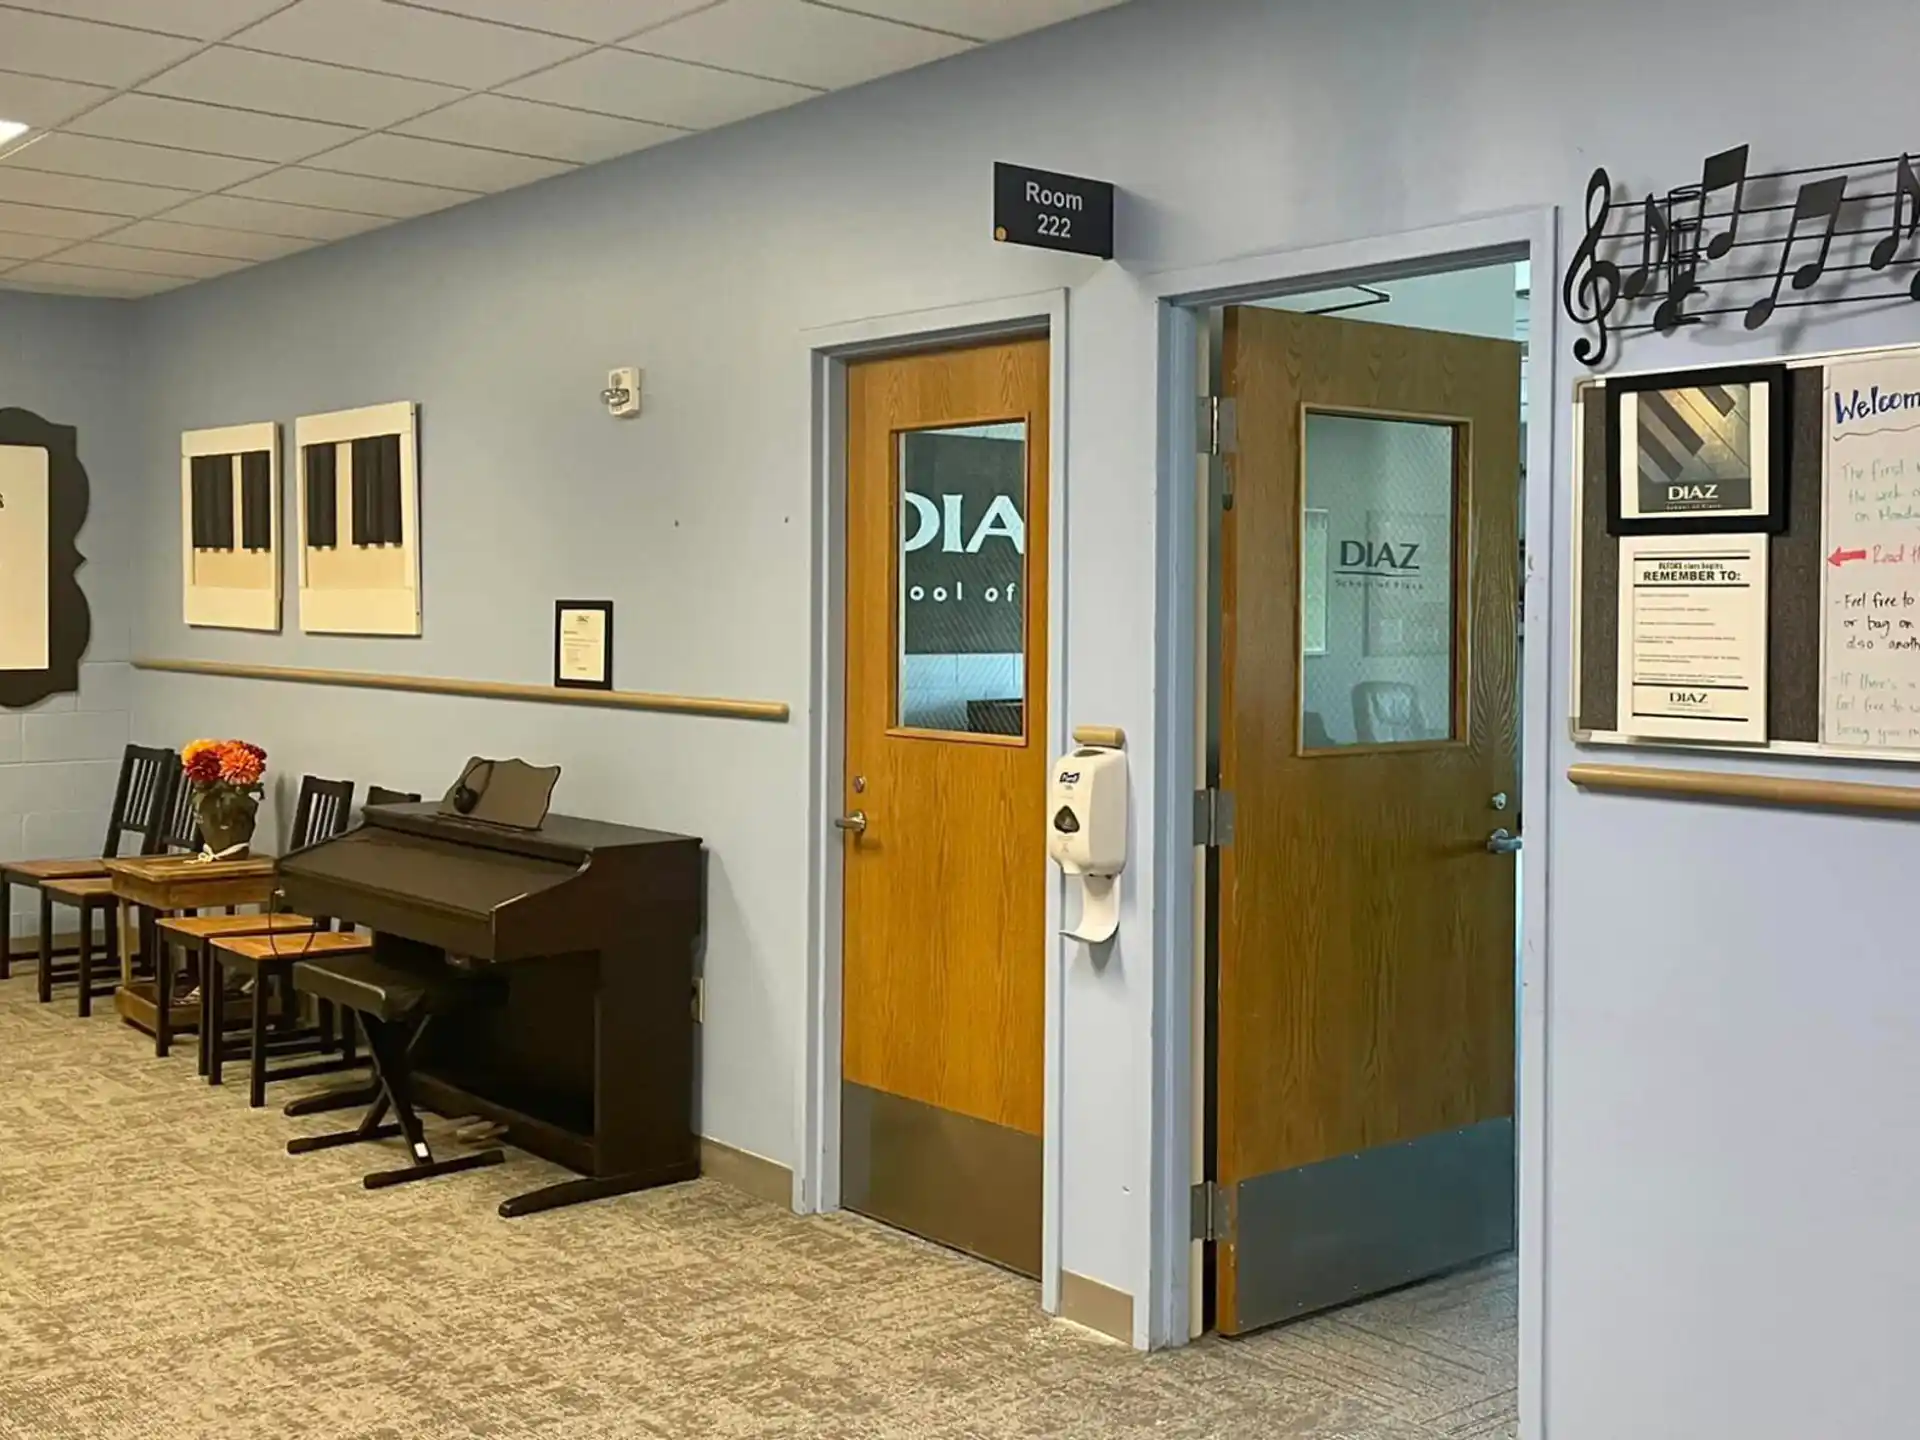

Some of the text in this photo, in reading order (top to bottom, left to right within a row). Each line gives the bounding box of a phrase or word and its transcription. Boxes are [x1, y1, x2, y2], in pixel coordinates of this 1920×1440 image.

[1026, 181, 1083, 212] Room
[1037, 213, 1071, 239] 222
[1668, 484, 1719, 501] DIAZ
[1340, 540, 1420, 570] DIAZ
[1643, 570, 1741, 581] REMEMBER TO:
[985, 583, 1016, 602] of
[1903, 591, 1915, 608] to
[1843, 619, 1859, 628] or
[1899, 619, 1914, 629] on
[1669, 692, 1709, 703] DIAZ
